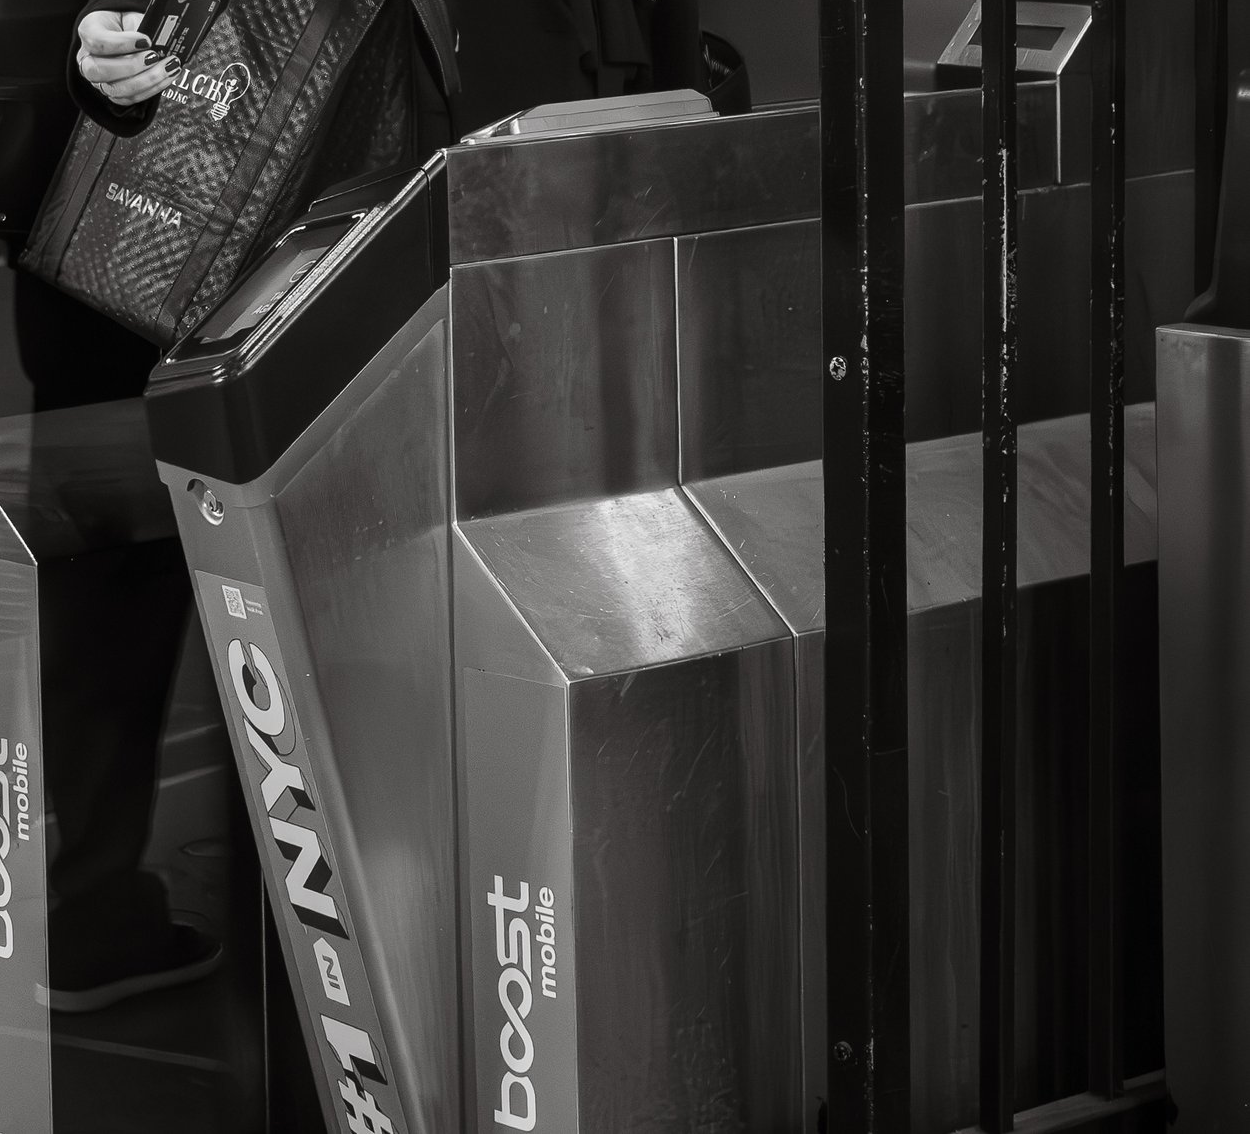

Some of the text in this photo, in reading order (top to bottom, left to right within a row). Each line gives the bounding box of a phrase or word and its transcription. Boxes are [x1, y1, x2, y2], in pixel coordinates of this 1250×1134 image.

[105, 182, 182, 229] SAVANNA
[11, 741, 30, 842] mobile
[227, 638, 350, 940] NYC
[540, 885, 557, 1000] mobile
[486, 874, 537, 1133] boost
